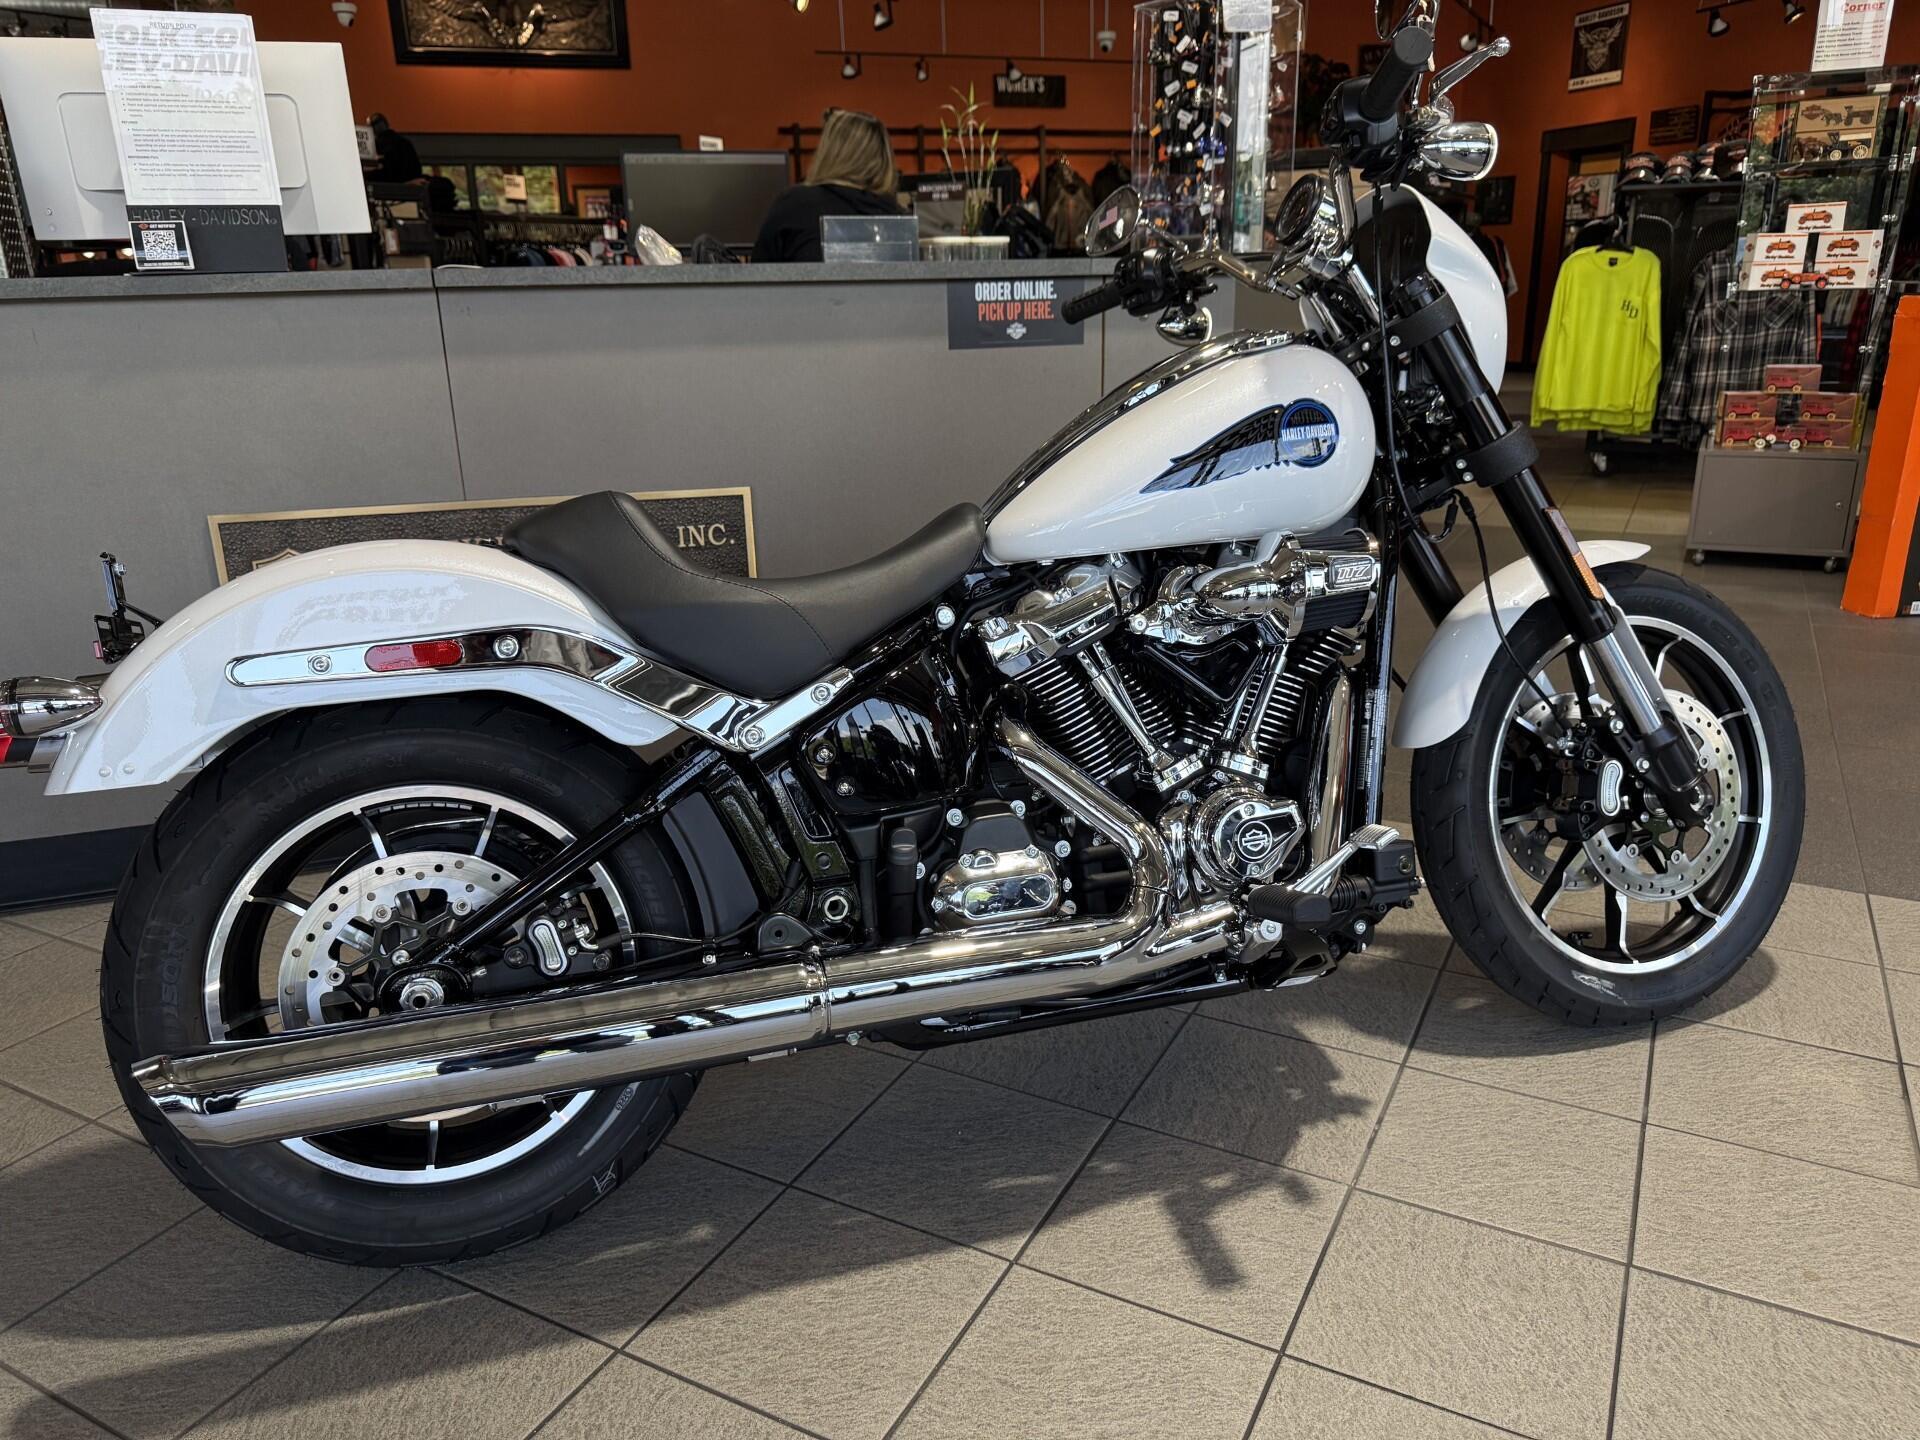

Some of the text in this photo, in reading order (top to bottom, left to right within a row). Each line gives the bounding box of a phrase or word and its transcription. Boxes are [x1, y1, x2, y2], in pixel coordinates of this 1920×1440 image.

[1843, 2, 1885, 13] Corner
[975, 279, 1058, 301] ORDER ONLINE.
[978, 300, 1055, 322] PICK UP HERE.
[1281, 423, 1336, 442] HARLEY-DAVIDSON
[676, 523, 736, 548] INC.
[1337, 563, 1371, 580] 117
